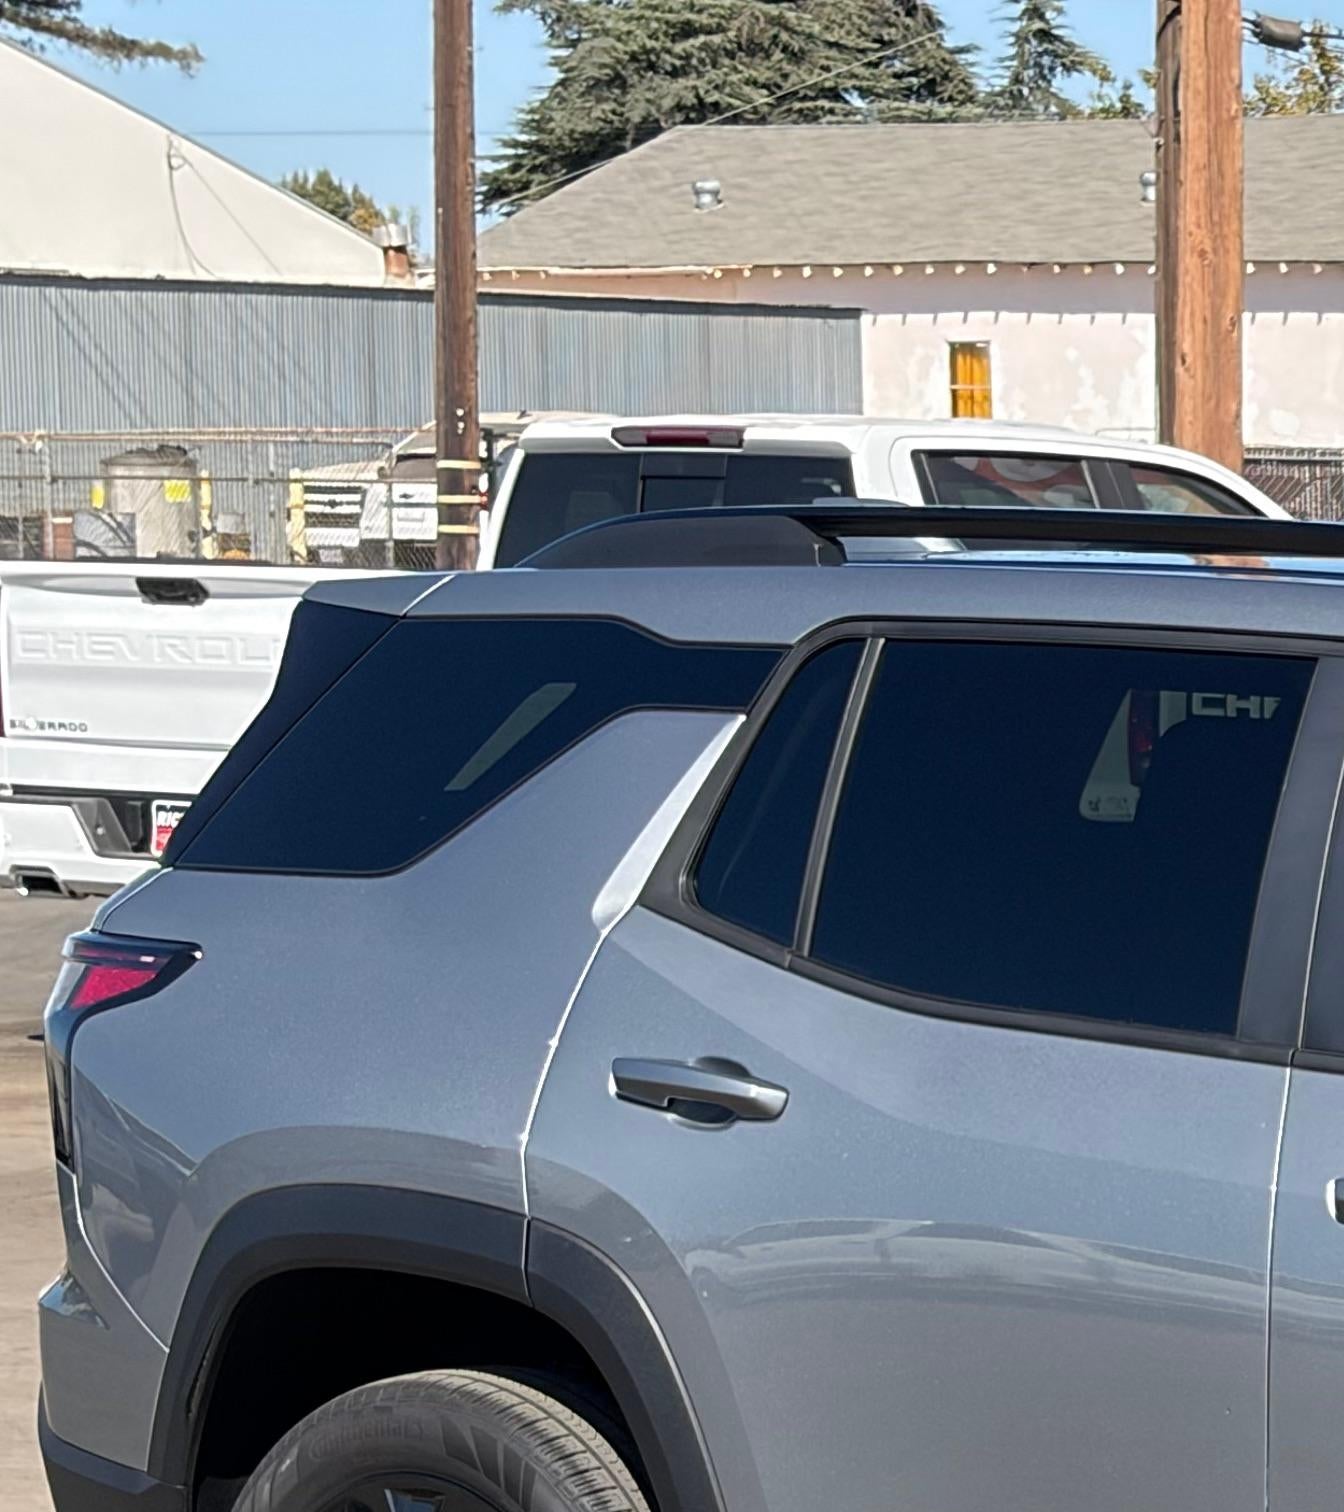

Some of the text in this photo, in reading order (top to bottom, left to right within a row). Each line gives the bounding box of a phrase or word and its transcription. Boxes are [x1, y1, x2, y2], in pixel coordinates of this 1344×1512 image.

[16, 629, 284, 666] CHEVROL
[9, 718, 88, 733] SILERADO
[157, 810, 185, 828] RIC
